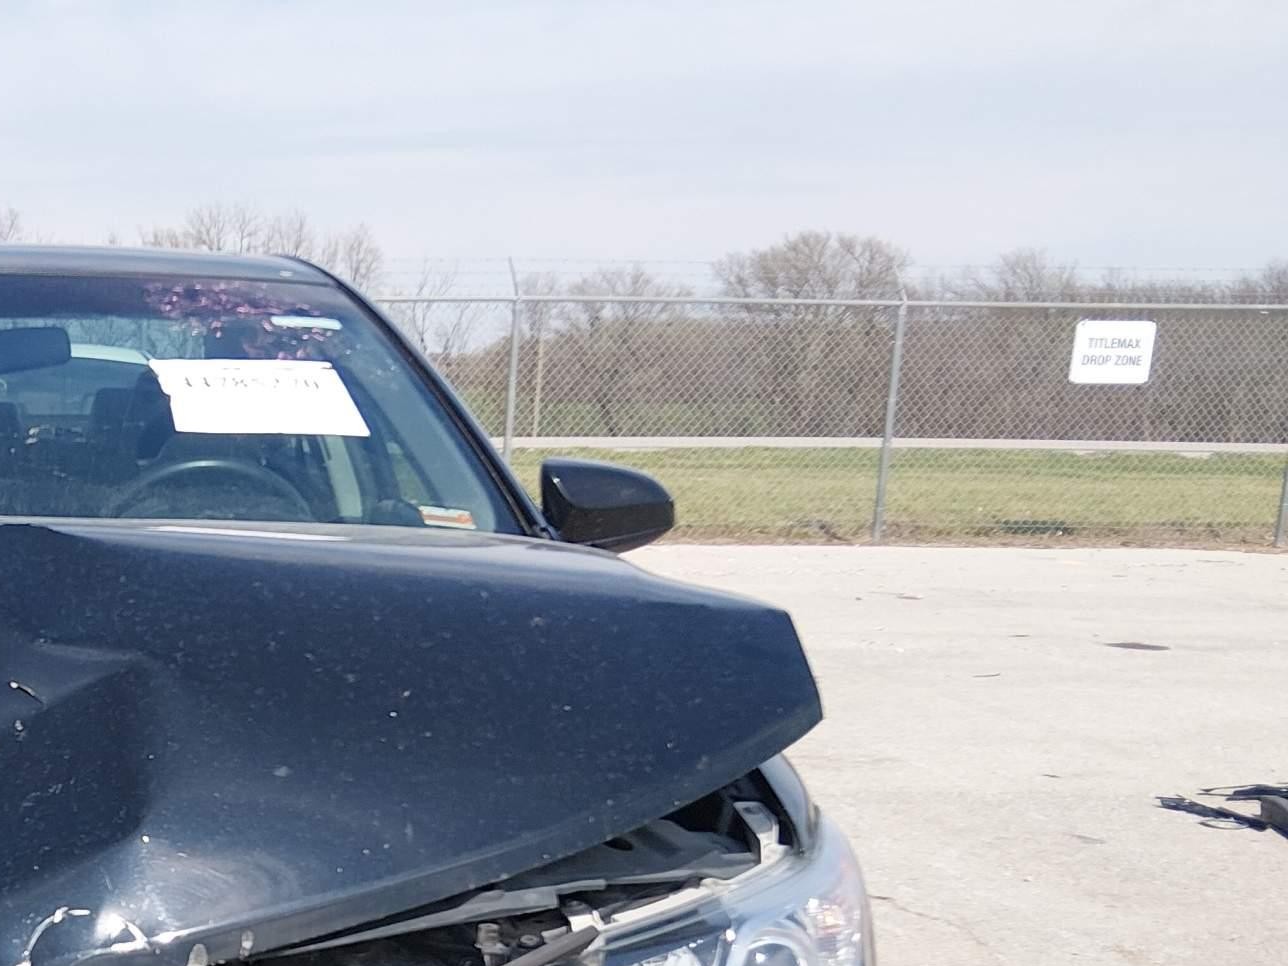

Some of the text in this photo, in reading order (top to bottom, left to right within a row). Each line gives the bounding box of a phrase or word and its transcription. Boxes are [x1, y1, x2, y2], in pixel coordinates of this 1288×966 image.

[1088, 337, 1142, 349] TITLEMAX
[1081, 354, 1143, 366] DROP ZONE
